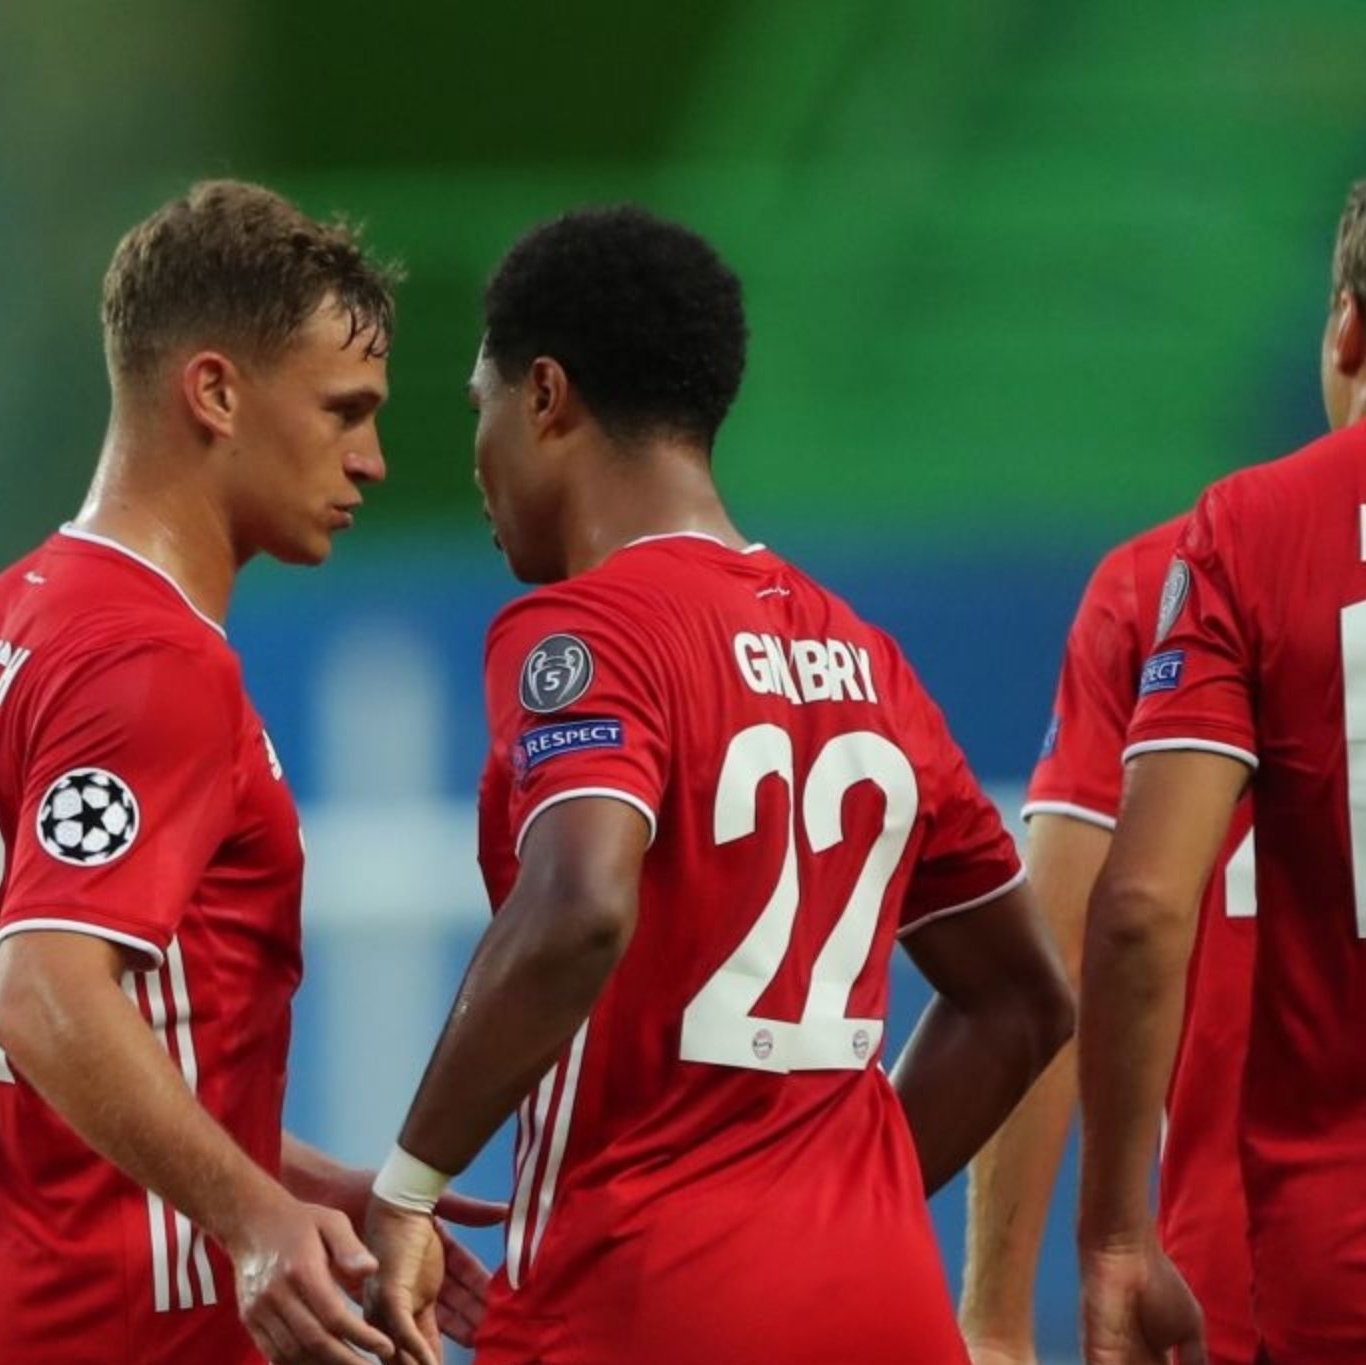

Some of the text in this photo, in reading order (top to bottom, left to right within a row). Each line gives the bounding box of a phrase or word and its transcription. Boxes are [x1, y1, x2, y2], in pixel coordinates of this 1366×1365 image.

[543, 670, 561, 691] 5
[526, 727, 620, 758] RESPECT
[680, 723, 919, 1073] 22
